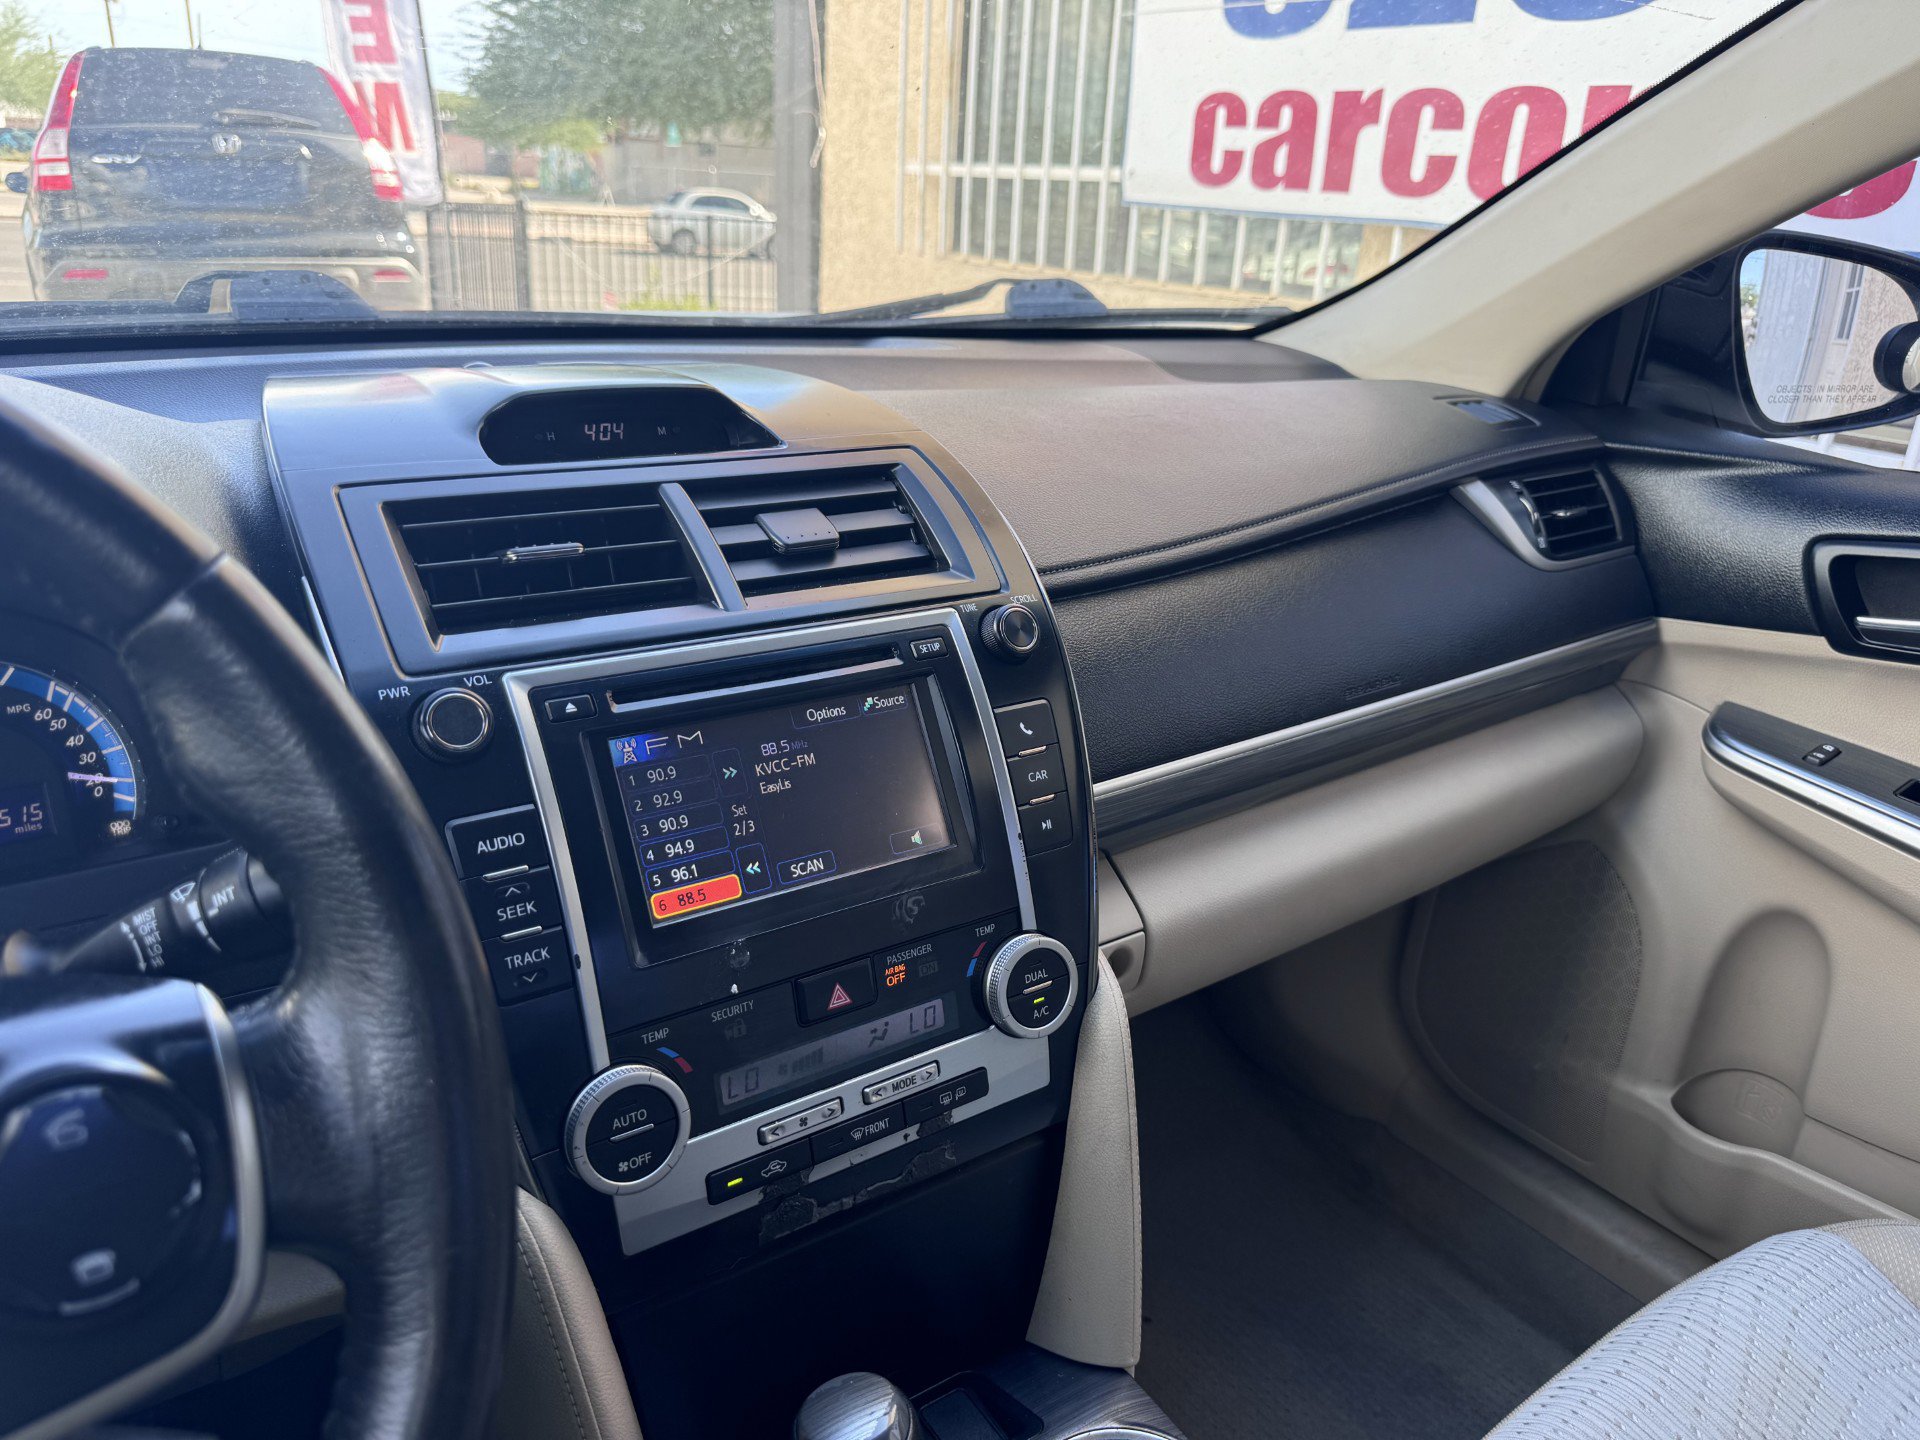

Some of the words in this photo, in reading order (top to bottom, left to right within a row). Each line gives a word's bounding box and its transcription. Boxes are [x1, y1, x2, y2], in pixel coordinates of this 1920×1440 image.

[1776, 385, 1812, 394] OBJECTS
[1816, 385, 1825, 393] IN
[1827, 385, 1857, 393] MIRROR
[1859, 384, 1875, 393] ARE
[1767, 395, 1800, 404] CLOSER
[1802, 395, 1823, 403] THAN
[1826, 395, 1845, 403] THEY
[1847, 395, 1877, 403] APPEAR
[546, 431, 556, 441] H
[657, 426, 667, 435] M
[1010, 594, 1038, 605] SCROLL
[960, 603, 978, 613] TUNE
[919, 642, 940, 654] SETUP
[463, 674, 492, 687] VOL
[377, 685, 411, 701] PWR
[6, 703, 31, 715] MPG
[873, 694, 905, 709] Source
[34, 708, 52, 721] 60
[806, 706, 847, 722] Options
[50, 718, 67, 731] 50
[66, 734, 84, 747] 40
[645, 730, 704, 755] FM
[761, 739, 790, 756] 88.5
[791, 740, 808, 750] MHz
[79, 751, 96, 765] 30
[754, 752, 816, 777] KVCC-FM
[629, 775, 636, 786] 1
[647, 765, 677, 783] 90.9
[1028, 769, 1048, 782] CAR
[94, 786, 103, 797] 0
[634, 800, 643, 812] 2
[653, 790, 683, 808] 92.9
[731, 804, 748, 817] Set
[14, 822, 43, 834] miles
[640, 824, 650, 836] 3
[658, 814, 689, 833] 90.9
[733, 820, 756, 836] 2/3
[476, 832, 525, 854] AUDIO
[646, 850, 655, 862] 4
[665, 839, 695, 858] 94.9
[652, 874, 662, 887] 5
[670, 864, 699, 883] 96.1
[790, 857, 824, 878] SCAN
[658, 899, 667, 912] 6
[677, 888, 707, 907] 88.5
[132, 906, 156, 926] MIST
[496, 900, 537, 921] SEEK
[139, 920, 158, 936] OFF
[975, 923, 996, 937] TEMP
[144, 931, 161, 946] INT
[148, 944, 163, 957] LO
[504, 946, 550, 969] TRACK
[886, 943, 933, 966] PASSENGER
[151, 955, 165, 968] HI
[885, 967, 894, 976] AIR
[895, 963, 906, 973] BAG
[886, 972, 906, 987] OFF
[1024, 968, 1048, 984] DUAL
[711, 1000, 754, 1023] SECURITY
[910, 1004, 936, 1034] LO
[1033, 1005, 1049, 1019] A/C
[641, 1027, 670, 1045] TEMP
[727, 1067, 760, 1100] LO
[891, 1075, 917, 1093] MODE
[612, 1108, 648, 1130] AUTO
[865, 1117, 890, 1137] FRONT
[629, 1151, 652, 1169] OFF
